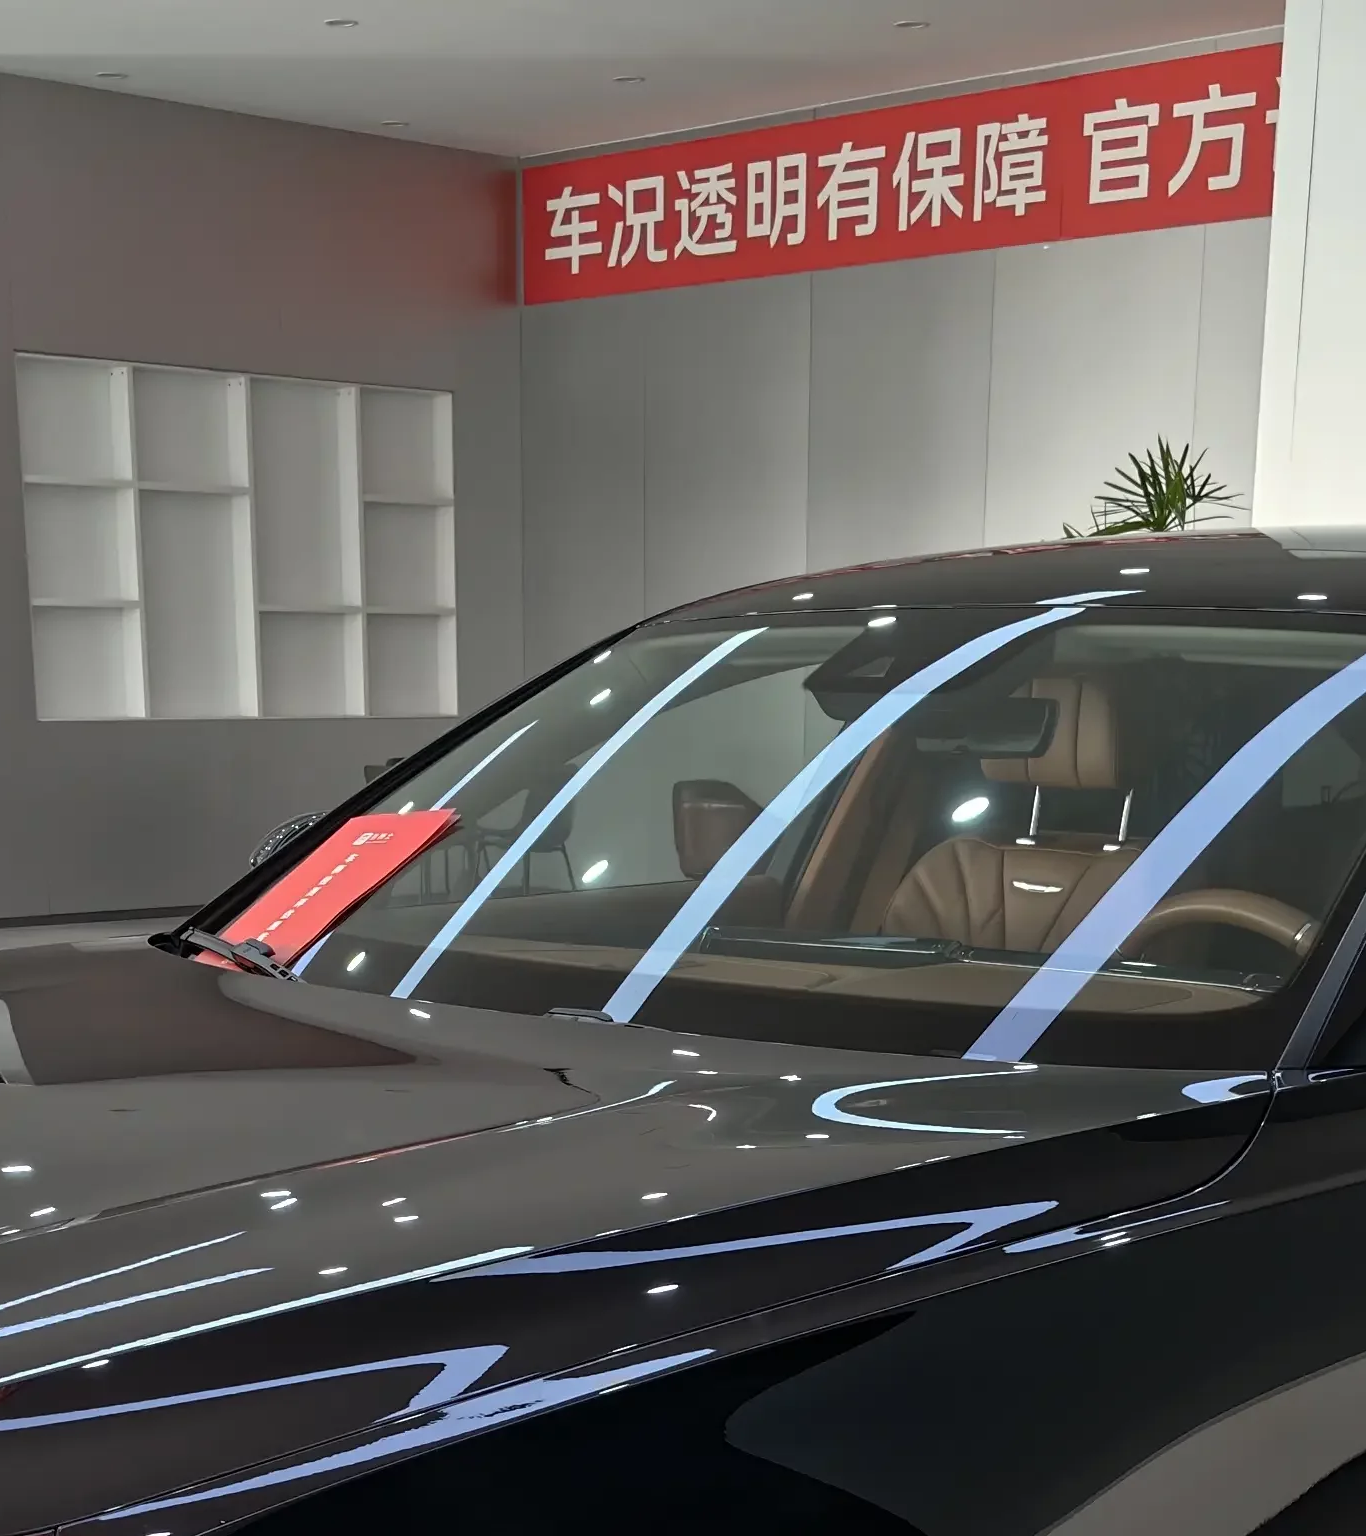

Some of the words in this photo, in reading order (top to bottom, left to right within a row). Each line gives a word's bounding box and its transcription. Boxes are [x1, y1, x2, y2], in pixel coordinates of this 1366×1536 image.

[544, 113, 1050, 275] 车况透明有保障
[1083, 76, 1282, 204] 官方
